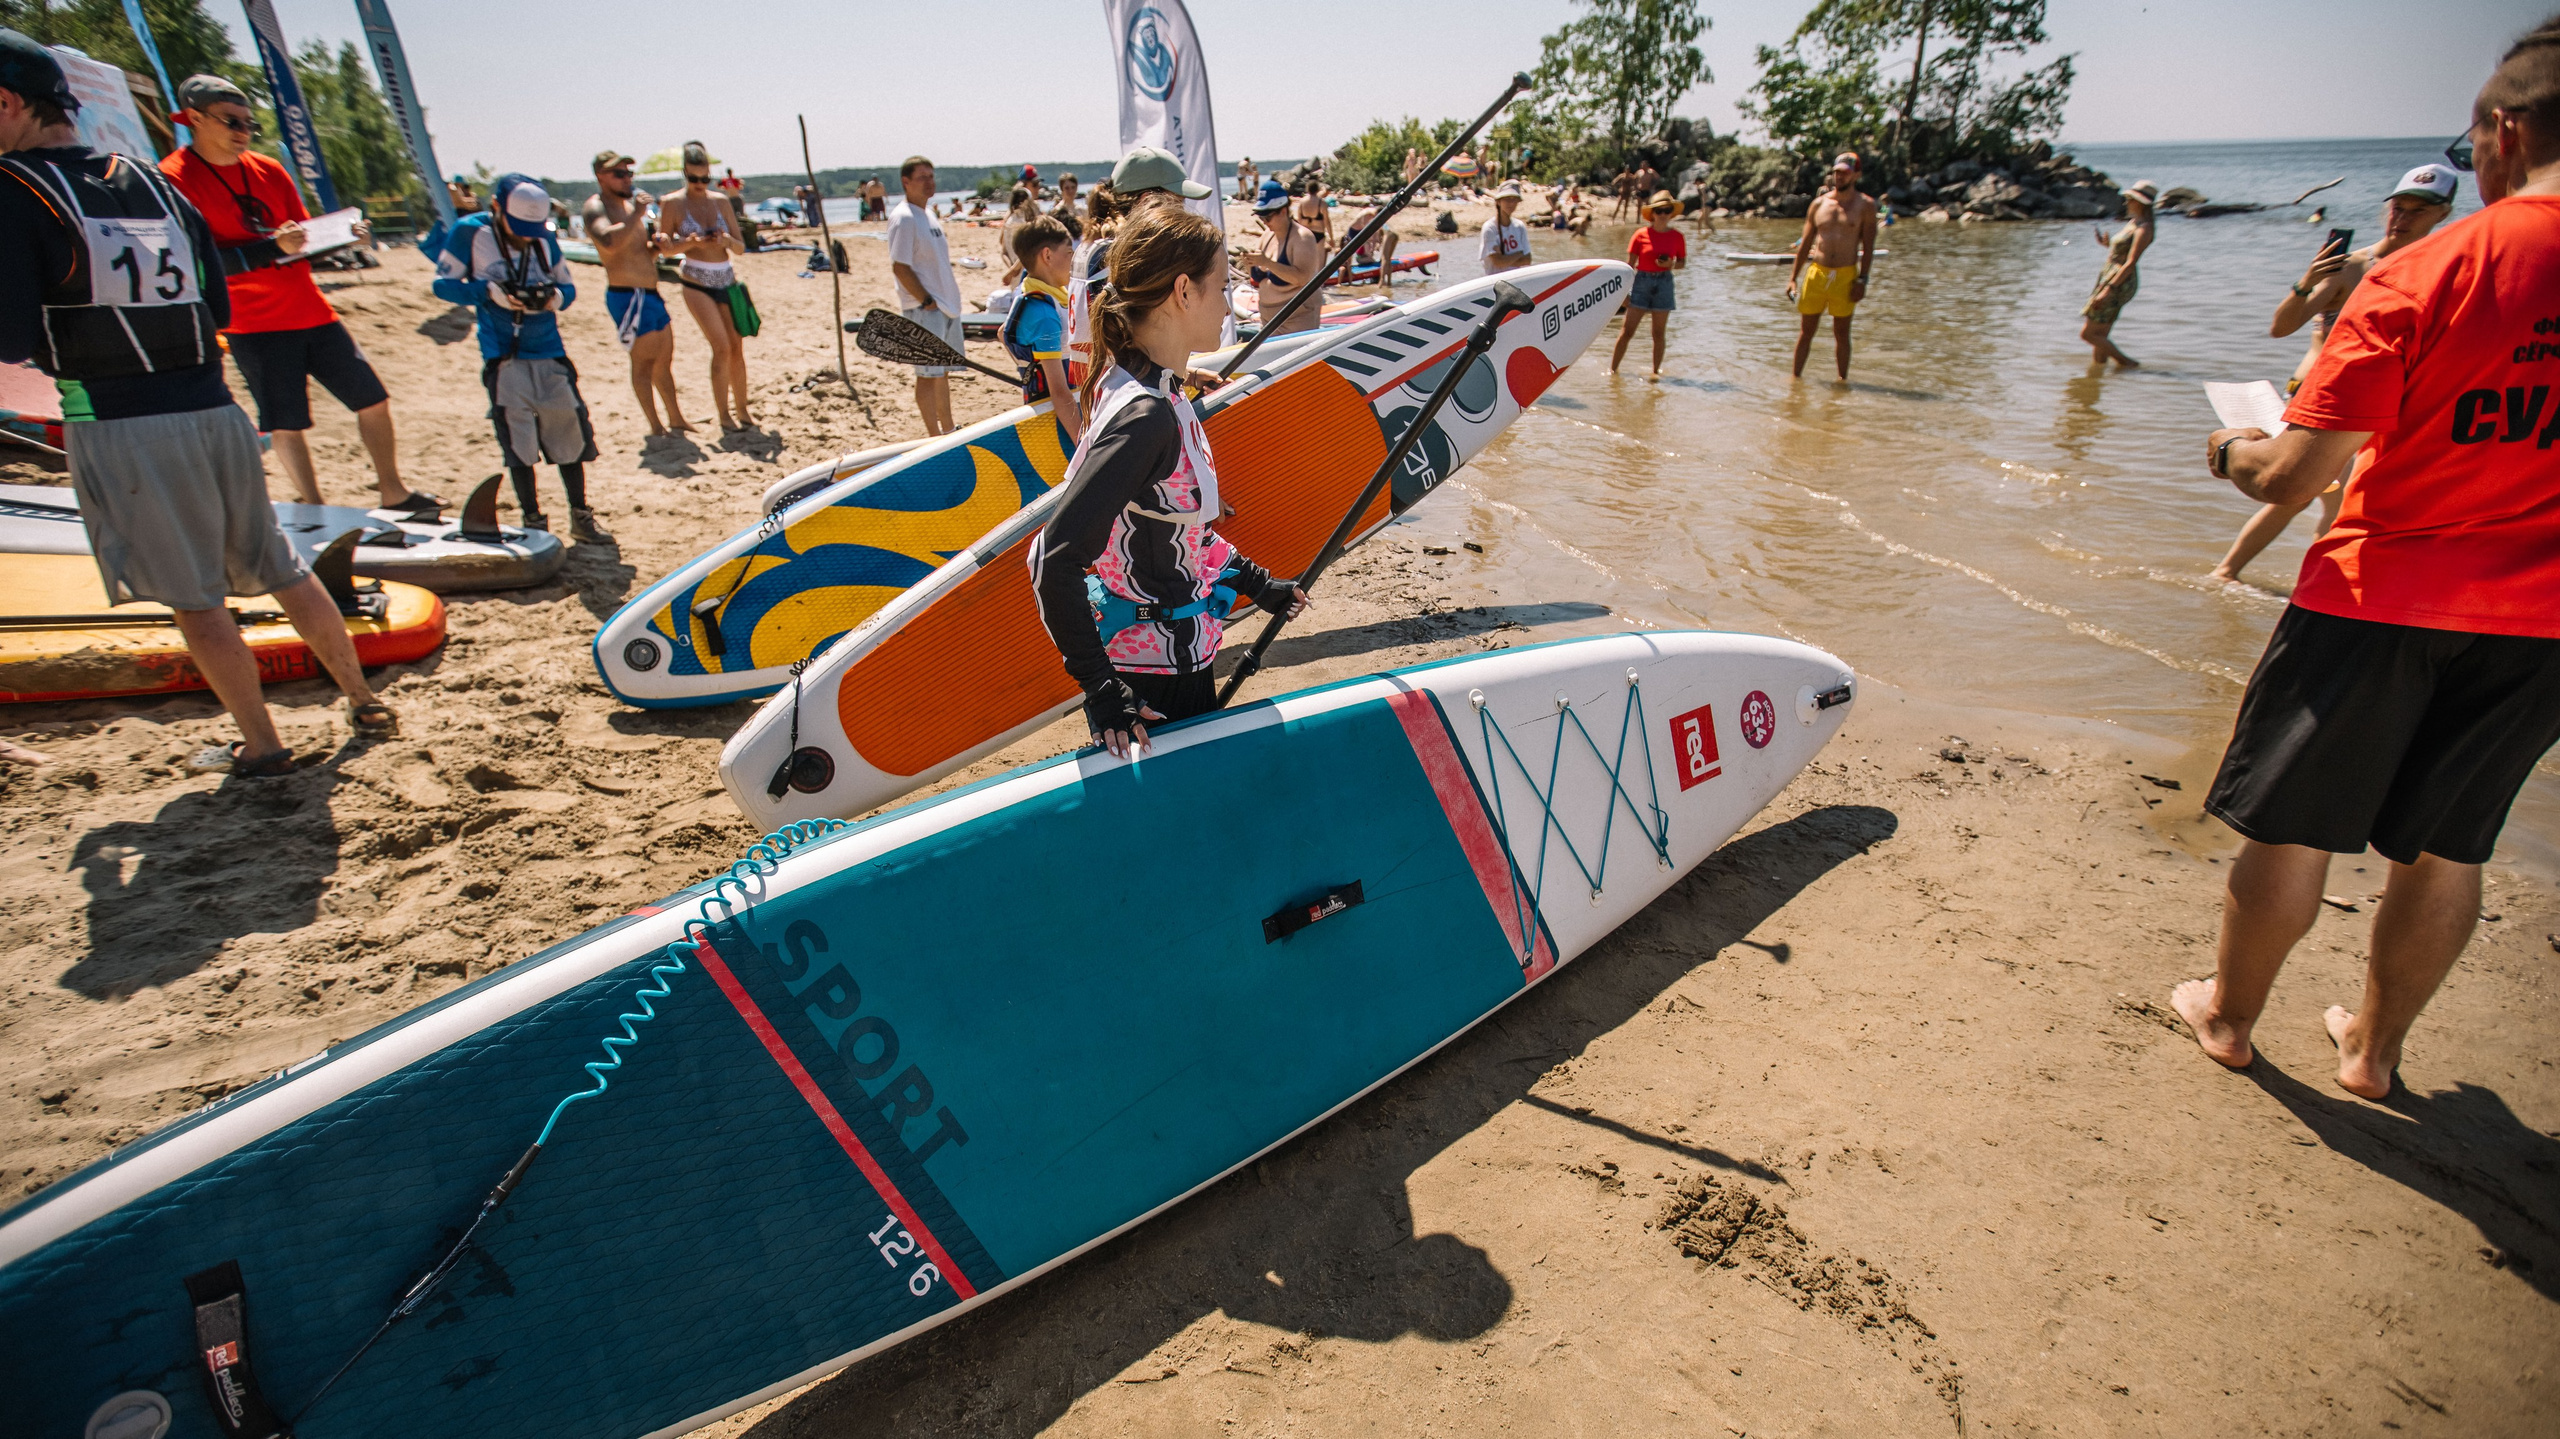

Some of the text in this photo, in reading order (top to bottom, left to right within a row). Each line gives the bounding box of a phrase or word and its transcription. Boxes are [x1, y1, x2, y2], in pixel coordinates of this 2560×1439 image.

[111, 246, 184, 303] 15
[1683, 717, 1721, 779] red
[1749, 700, 1767, 742] 634
[762, 919, 970, 1166] SPORT
[214, 1347, 239, 1367] red
